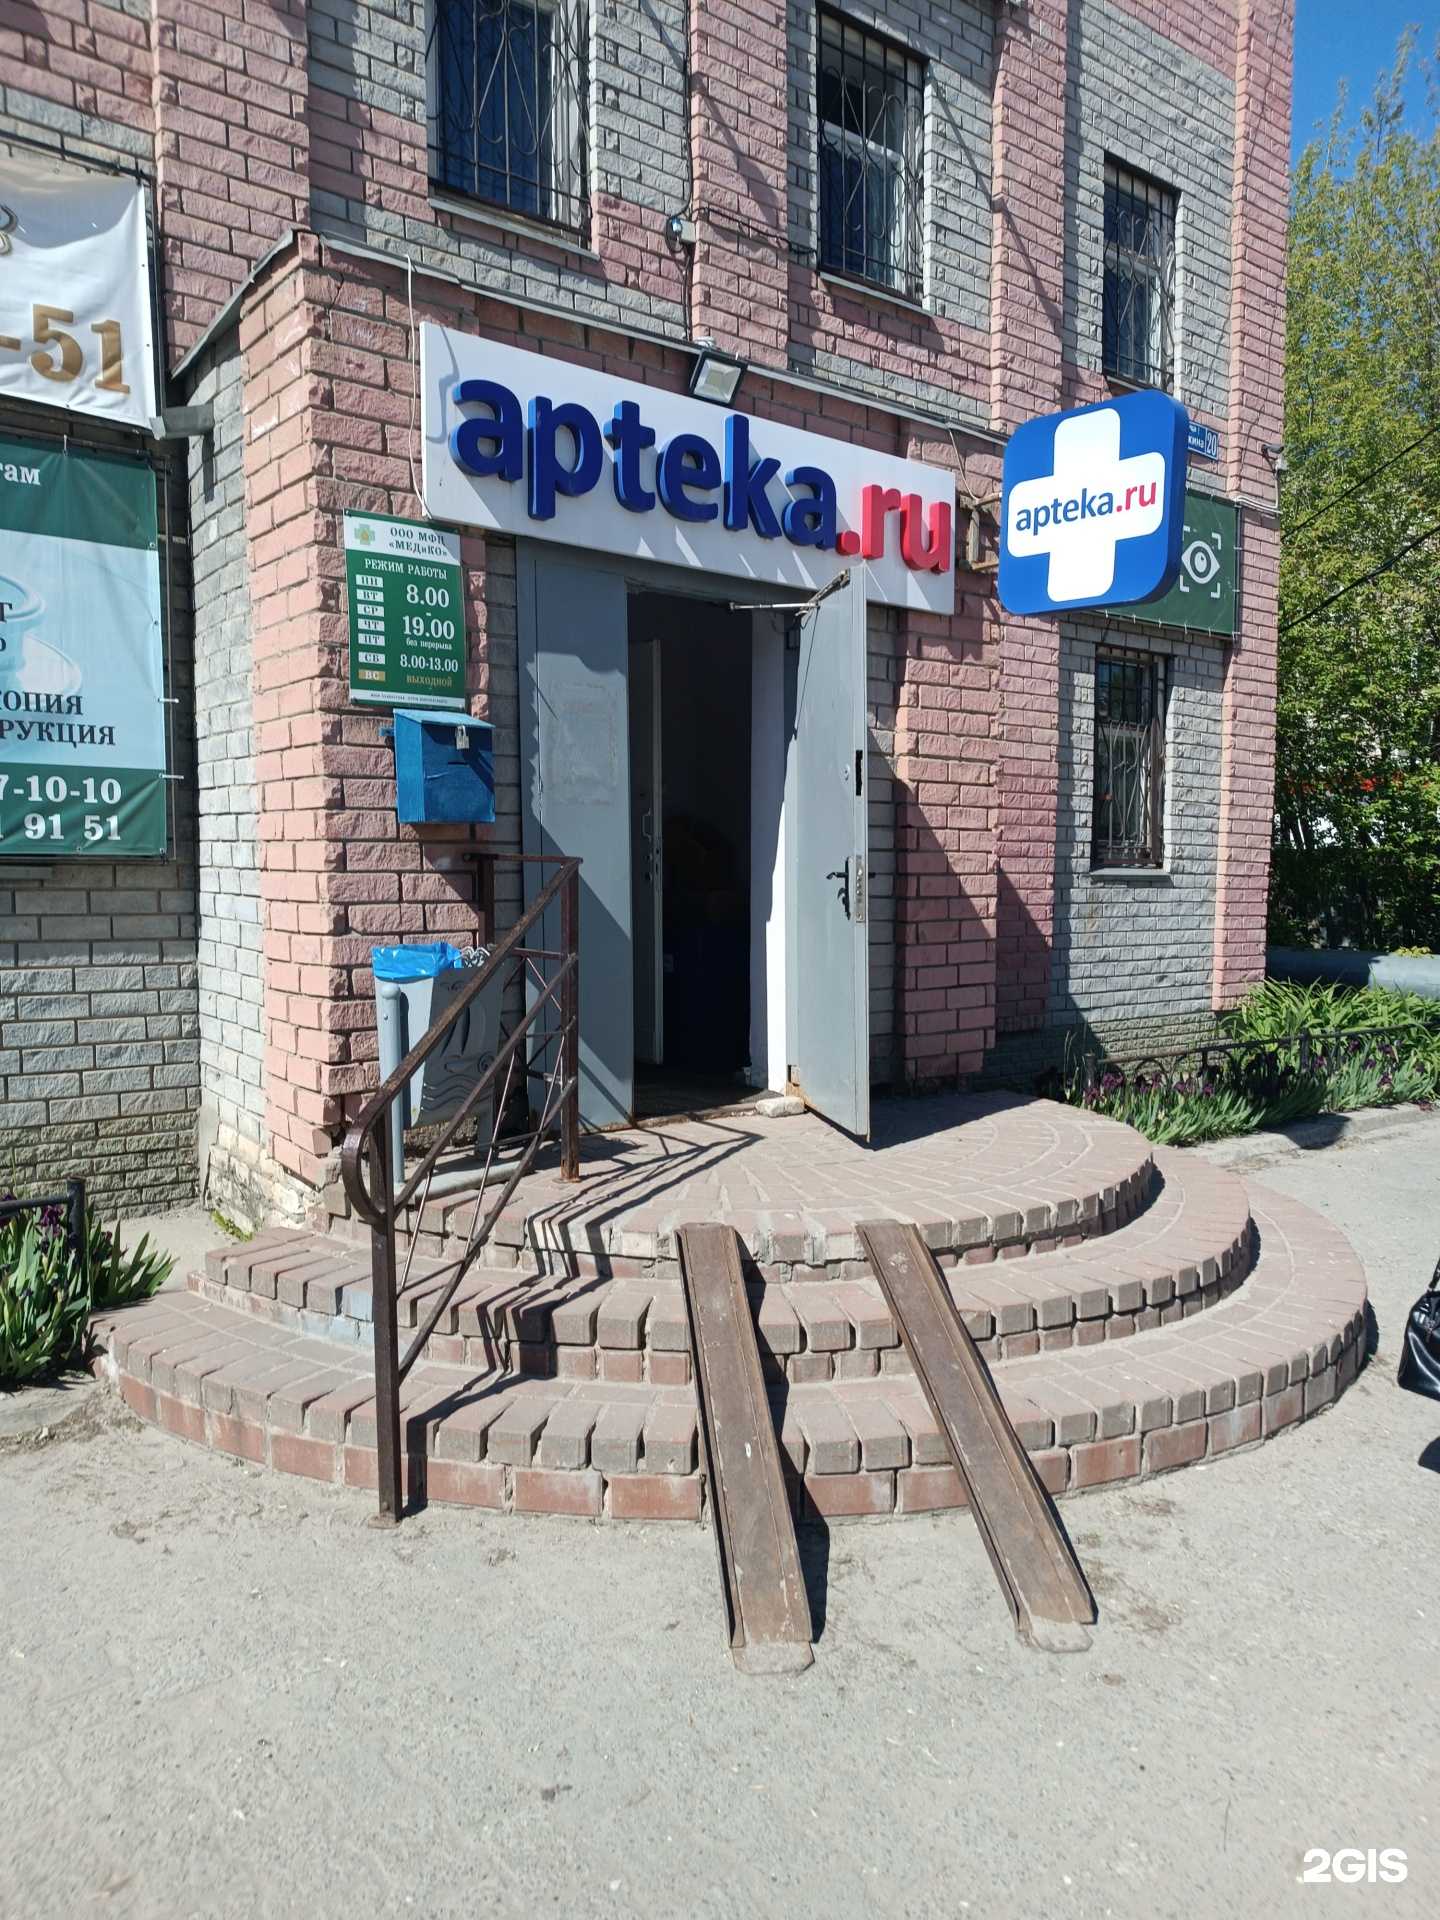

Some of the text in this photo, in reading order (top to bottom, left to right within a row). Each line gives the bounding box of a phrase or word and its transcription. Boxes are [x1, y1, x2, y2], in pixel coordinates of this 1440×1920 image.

[1207, 432, 1217, 456] 20
[449, 379, 952, 574] apteka.ru
[1015, 481, 1157, 536] apteka.ru
[390, 527, 414, 540] ООО
[364, 558, 448, 580] РЕЖИМ РАБОТЫ
[361, 575, 379, 584] ПН
[363, 589, 378, 600] ВТ
[406, 583, 450, 608] 8.00
[363, 605, 378, 614] СР
[363, 620, 379, 629] ЧТ
[402, 615, 455, 640] 19.00
[364, 635, 379, 645] ПТ
[364, 652, 379, 663] СБ
[400, 653, 459, 673] 8.00-13.00
[365, 670, 380, 681] ВС
[24, 813, 65, 841] 91
[84, 815, 121, 841] 51
